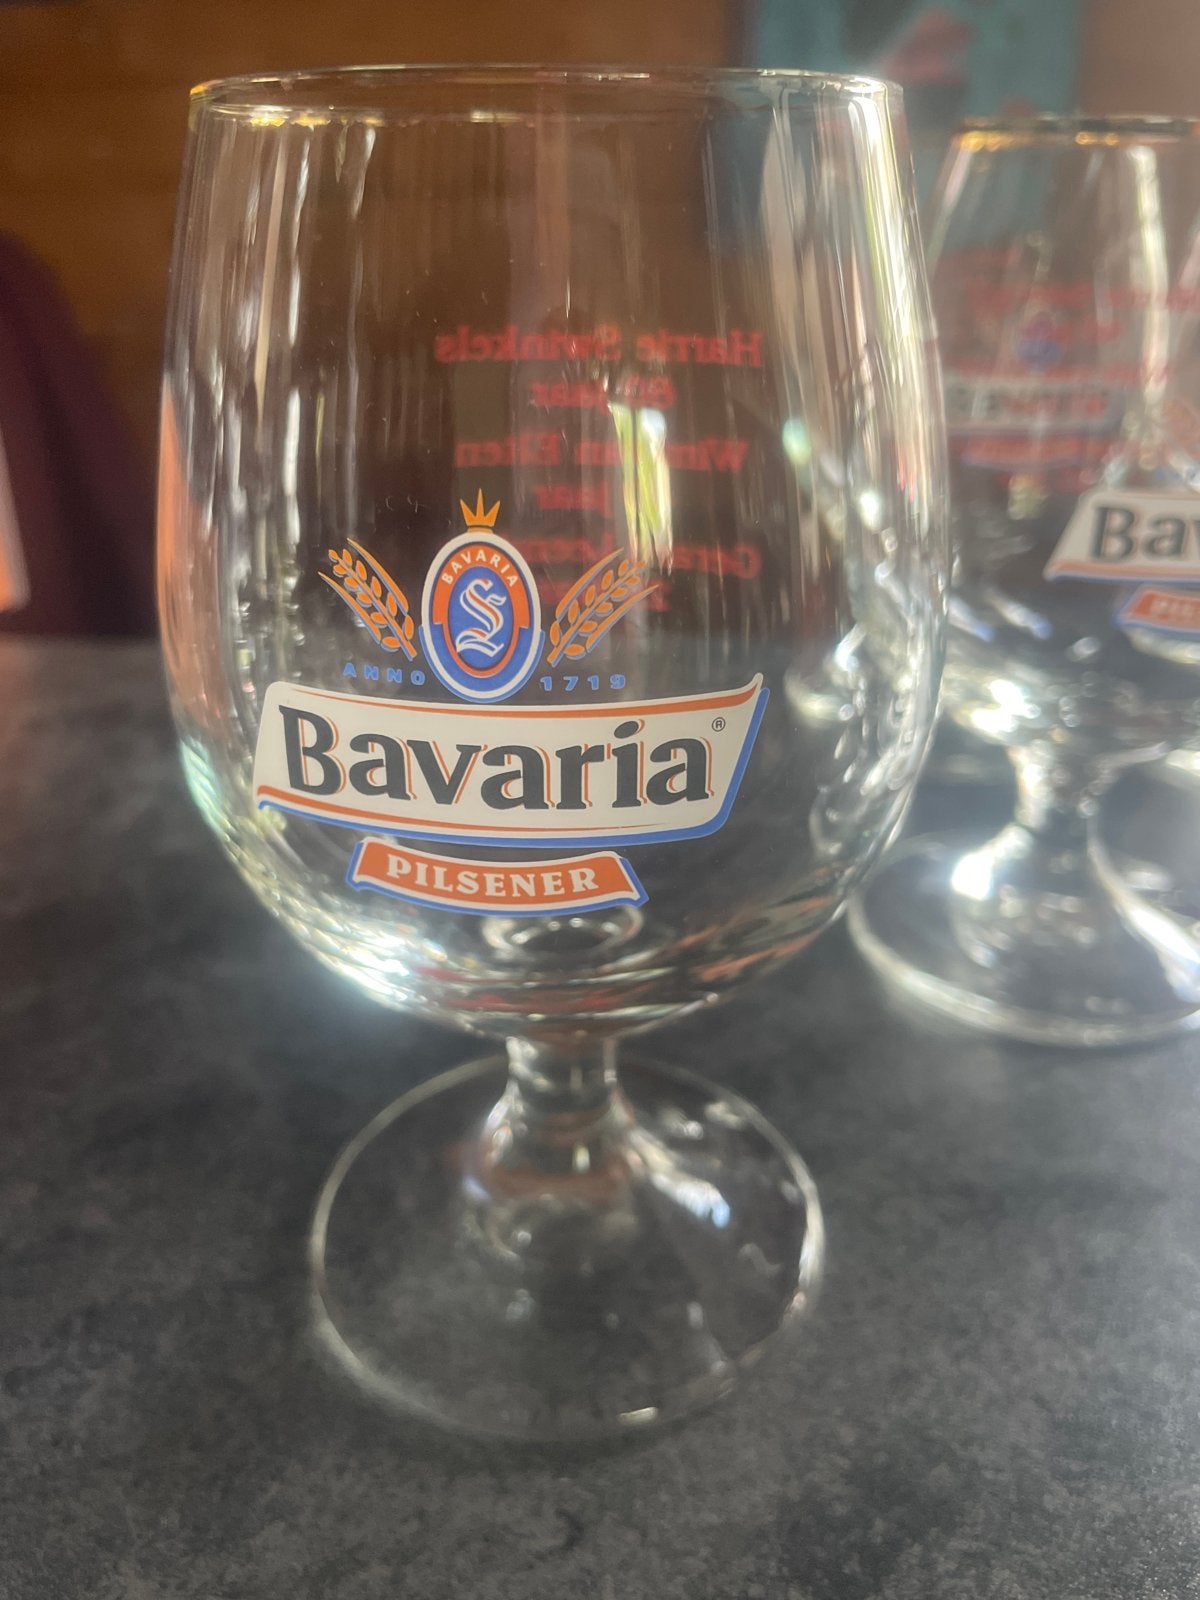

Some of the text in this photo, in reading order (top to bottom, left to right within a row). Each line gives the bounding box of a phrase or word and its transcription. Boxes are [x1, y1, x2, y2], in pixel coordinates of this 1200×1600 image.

[441, 549, 519, 587] BAVARIA
[342, 662, 627, 691] ANNO 1719
[278, 704, 715, 810] Bavaria
[386, 853, 599, 897] PILSENER
